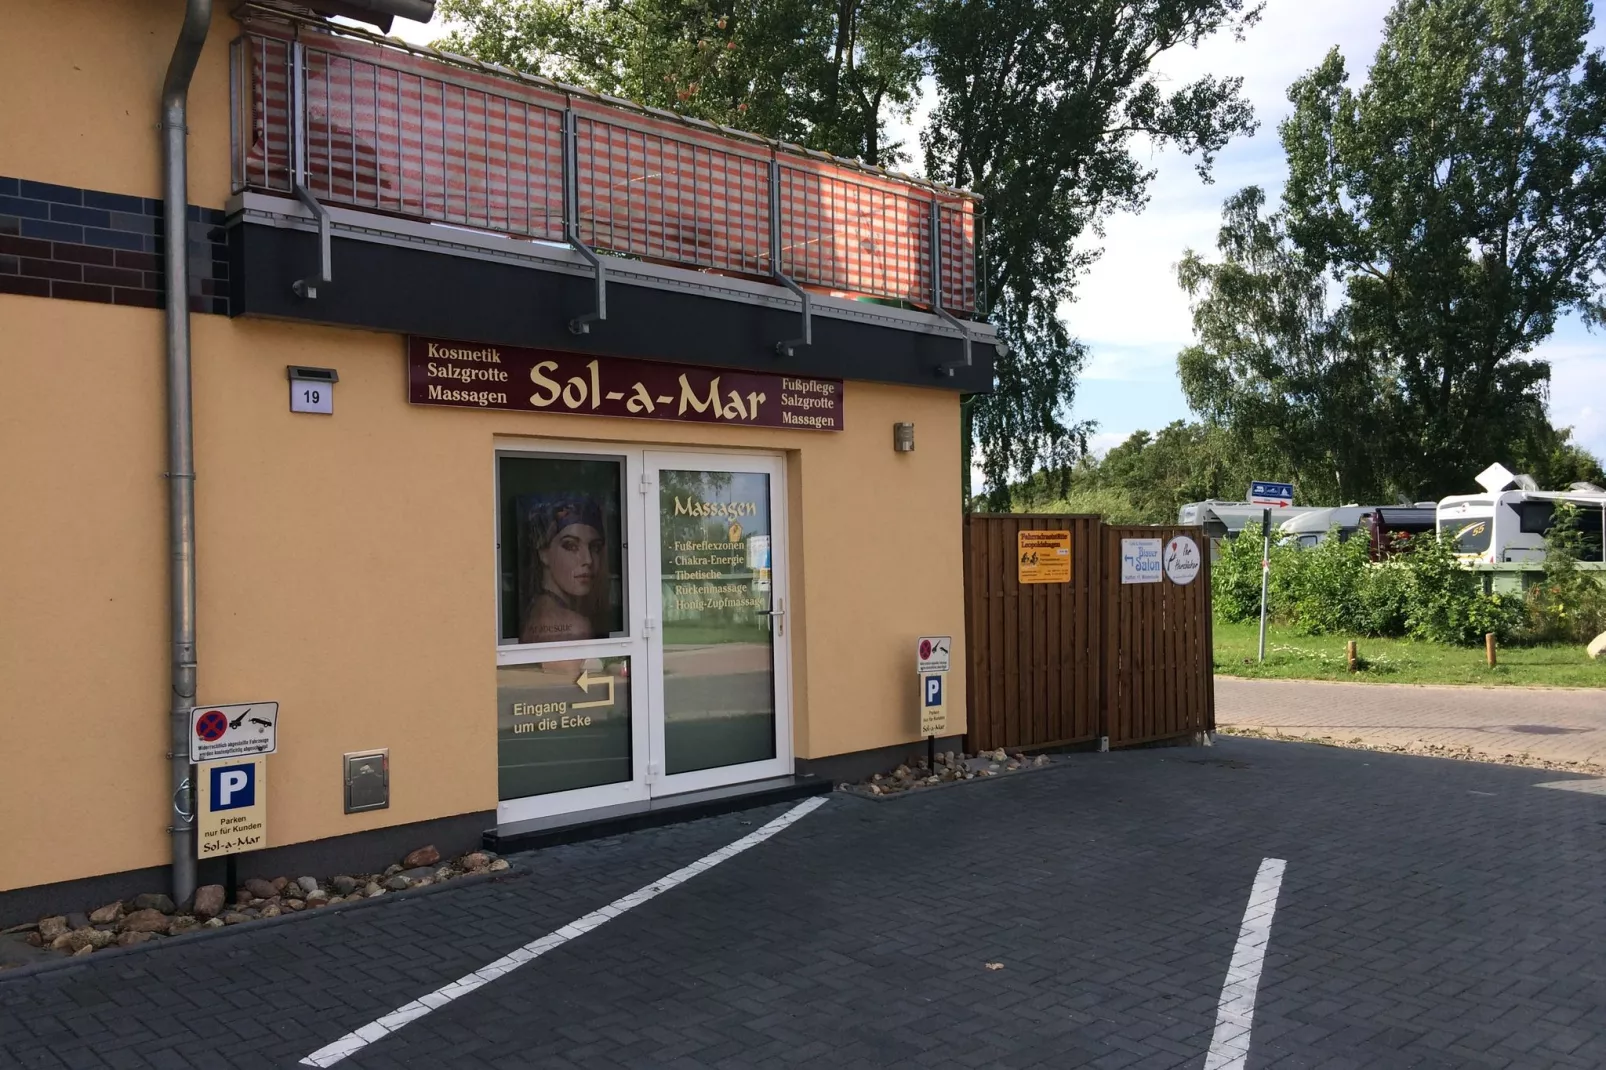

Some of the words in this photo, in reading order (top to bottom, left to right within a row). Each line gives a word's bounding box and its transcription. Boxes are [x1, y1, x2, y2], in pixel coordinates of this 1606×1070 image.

[428, 343, 501, 363] Kosmetik
[428, 362, 508, 383] Salzgrotte
[529, 359, 767, 421] Sol-a-Mar
[782, 378, 835, 394] Fußpflege
[304, 390, 320, 404] 19
[428, 385, 508, 406] Massagen
[781, 393, 834, 410] Salzgrotte
[782, 411, 835, 428] Massagen
[674, 495, 756, 522] Massagen
[674, 541, 745, 552] Fußreflexzonen
[675, 555, 744, 566] Chakra-Energie
[1135, 557, 1160, 571] Salon
[675, 570, 722, 580] Tibetische
[675, 583, 747, 595] Rückenmassage
[676, 597, 765, 611] Honig-Zupfmassage
[928, 679, 939, 703] P
[513, 701, 567, 717] Eingang
[514, 723, 535, 734] um
[538, 718, 558, 731] die
[561, 715, 592, 728] Ecke
[220, 770, 248, 806] P
[219, 827, 231, 835] für
[232, 822, 262, 833] Kunden
[220, 816, 246, 826] Parken
[203, 836, 261, 853] Sol-a-Mar
